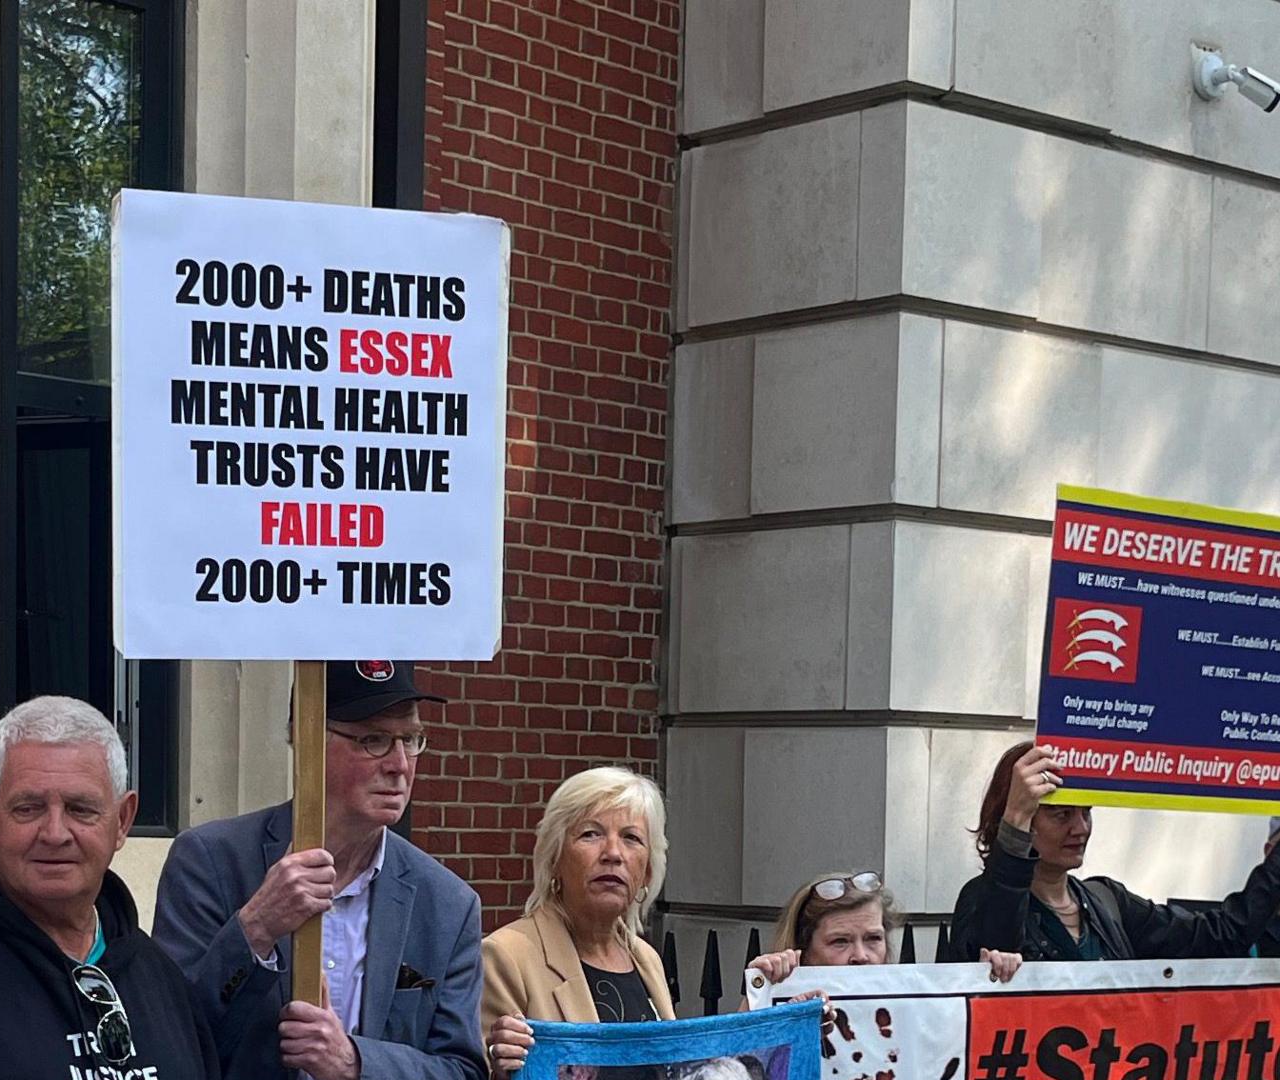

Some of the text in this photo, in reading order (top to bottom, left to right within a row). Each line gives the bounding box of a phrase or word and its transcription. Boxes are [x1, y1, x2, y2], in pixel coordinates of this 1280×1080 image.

[175, 259, 465, 321] 2000+ DEATHS
[192, 321, 453, 378] MEANS ESSEX
[171, 380, 468, 436] MENTAL HEALTH
[190, 441, 450, 492] TRUSTS HAVE
[261, 501, 384, 547] FAILED
[1064, 521, 1099, 553] WE
[1103, 528, 1203, 568] DESERVE
[1211, 542, 1251, 573] THE
[196, 558, 451, 605] 2000+ TIMES
[1160, 583, 1206, 599] witnesses
[1063, 696, 1154, 717] Only way bring any
[1066, 713, 1148, 732] meaningful change
[1221, 710, 1240, 724] Only
[1242, 712, 1259, 726] Way
[1222, 726, 1250, 740] Public
[1121, 752, 1172, 774] Public
[1177, 757, 1232, 784] Inquiry
